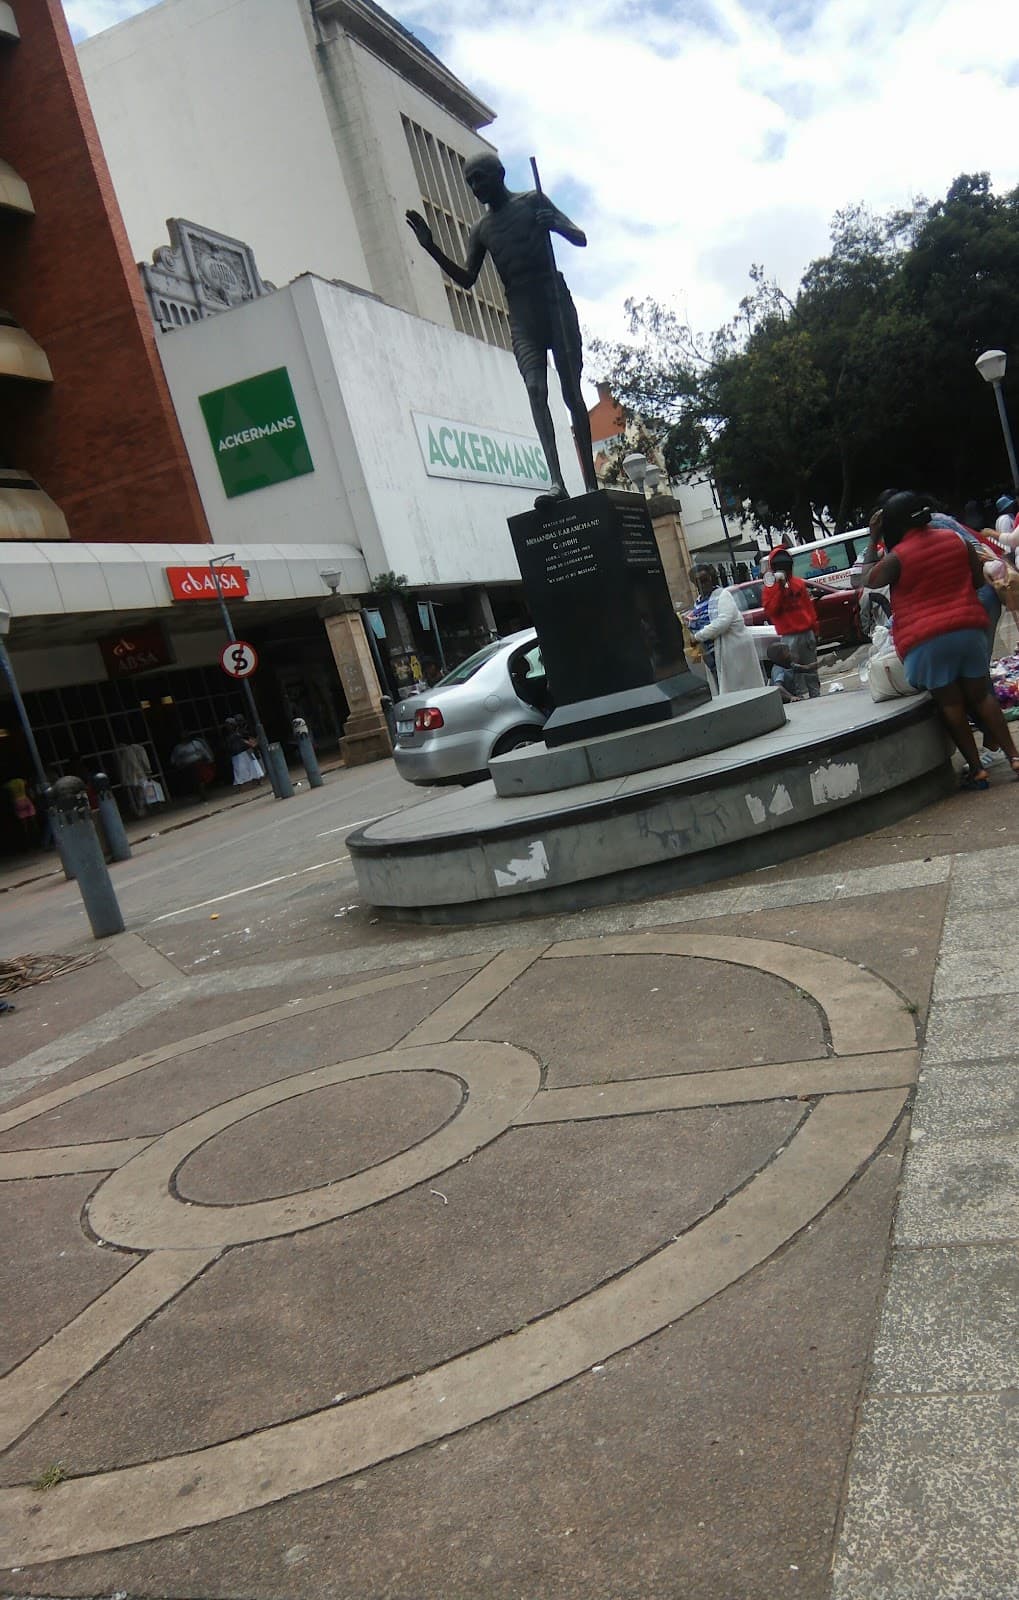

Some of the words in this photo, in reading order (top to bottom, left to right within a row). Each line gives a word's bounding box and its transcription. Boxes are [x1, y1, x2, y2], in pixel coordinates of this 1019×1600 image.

[218, 415, 297, 452] ACKERMANS
[427, 423, 549, 482] ACKERMANS
[204, 572, 241, 590] ABSA
